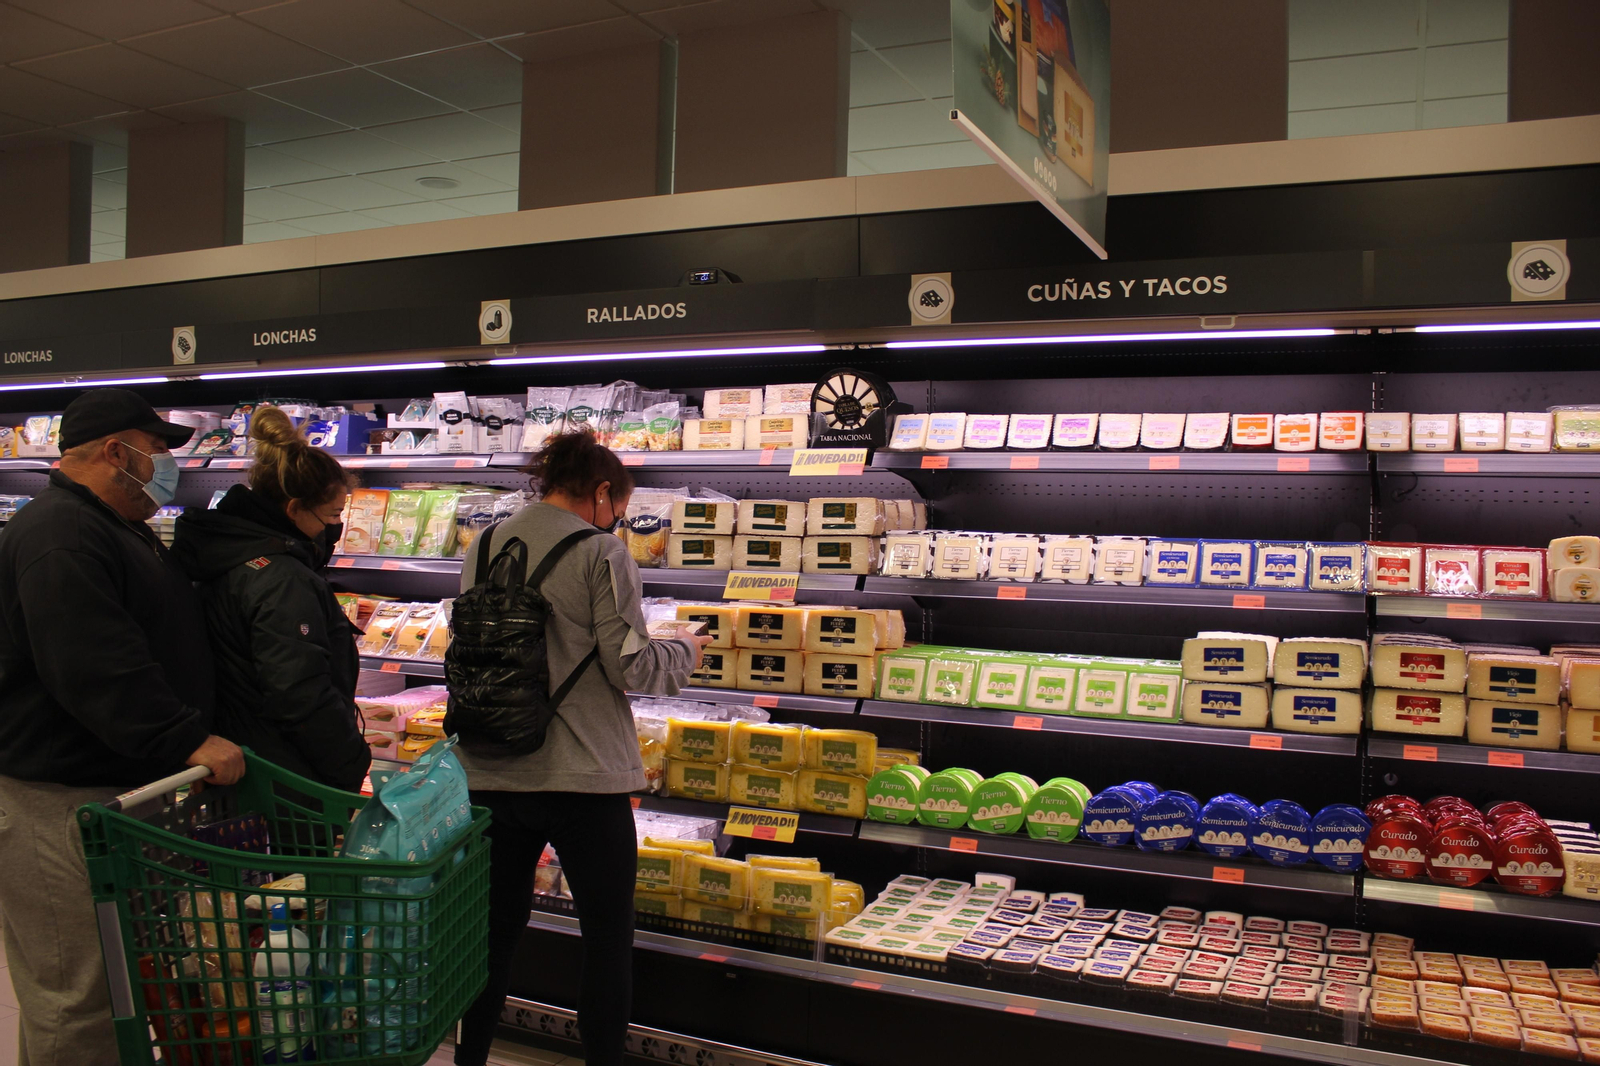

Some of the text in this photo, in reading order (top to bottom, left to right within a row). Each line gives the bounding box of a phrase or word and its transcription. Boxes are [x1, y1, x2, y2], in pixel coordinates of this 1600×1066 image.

[1027, 276, 1228, 302] CUÑAS Y TACOS
[587, 302, 686, 323] RALLADOS
[254, 328, 316, 346] LONCHAS
[4, 350, 52, 364] LONCHAS
[836, 406, 860, 414] QUESOS
[880, 780, 906, 791] Tierno
[931, 784, 957, 793] Tierno
[980, 790, 1007, 800] Tierno
[1040, 796, 1068, 806] Tierno
[1087, 805, 1131, 814] Semicurado
[1141, 810, 1186, 821] Semicurado
[1201, 816, 1248, 827] Semicurado
[1259, 818, 1306, 833] Semicurado
[1315, 824, 1365, 833] Semicurado
[1380, 830, 1418, 841] Curado
[1441, 836, 1480, 847] Curado
[1508, 844, 1548, 855] Curado
